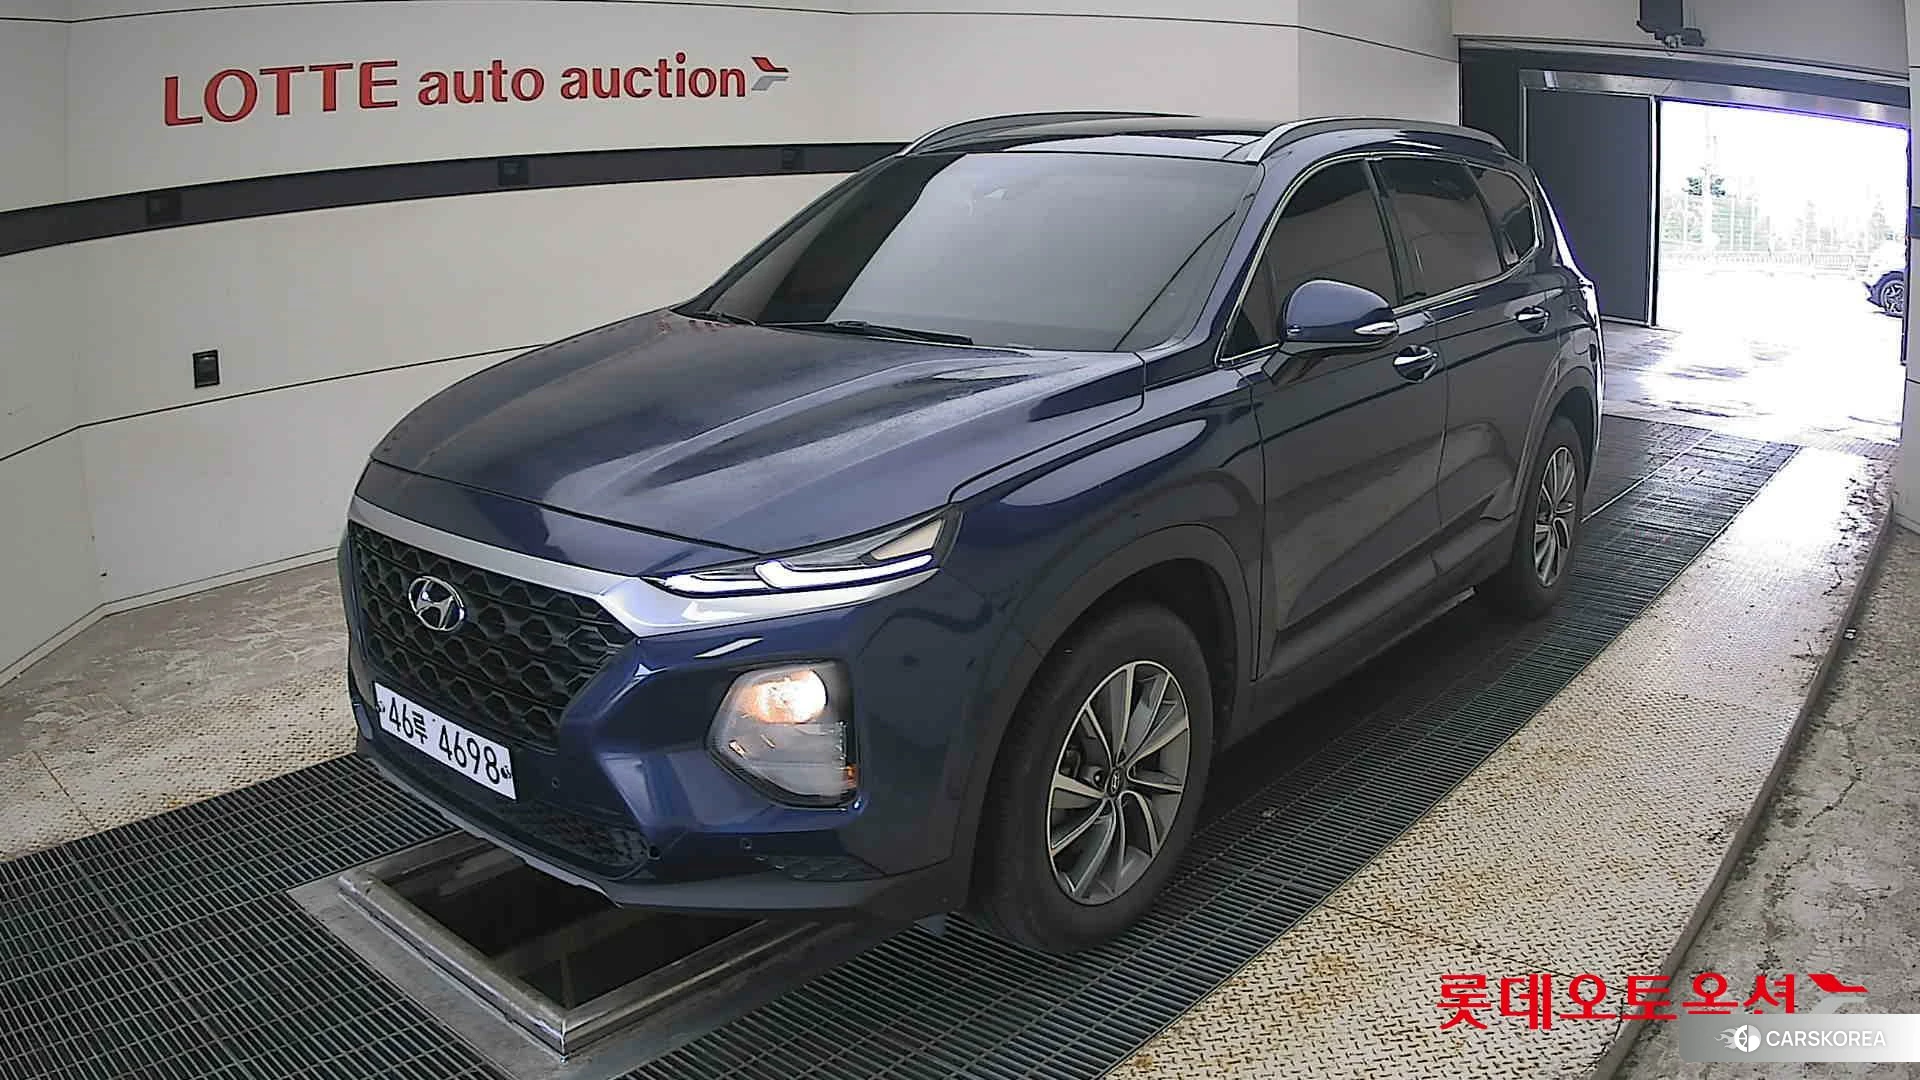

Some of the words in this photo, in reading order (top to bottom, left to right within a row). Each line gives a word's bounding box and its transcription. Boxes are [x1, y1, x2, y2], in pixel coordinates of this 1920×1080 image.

[164, 60, 398, 127] LOTTE
[417, 59, 545, 106] auto
[560, 52, 747, 99] auction
[439, 724, 500, 785] 4698
